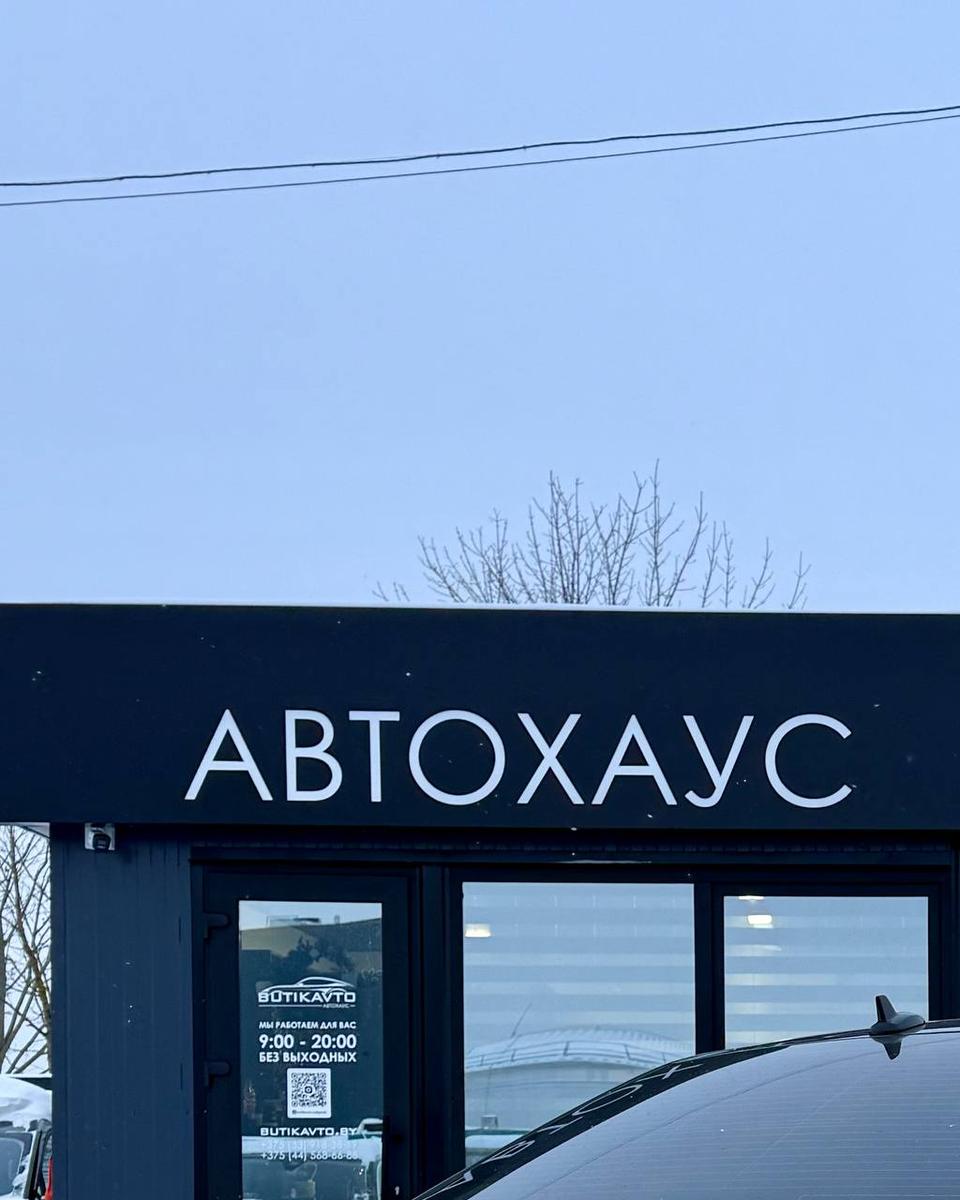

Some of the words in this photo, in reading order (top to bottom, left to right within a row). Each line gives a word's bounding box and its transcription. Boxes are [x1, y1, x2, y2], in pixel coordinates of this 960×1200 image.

[184, 708, 853, 809] АВТОХАУС
[258, 991, 356, 1003] BUTIKAVTO
[259, 1021, 274, 1029] МЫ
[275, 1021, 318, 1029] РАБОТАЕМ
[320, 1021, 337, 1029] ДЛЯ
[339, 1021, 357, 1029] ВАС
[259, 1034, 295, 1049] 9:00
[311, 1034, 357, 1049] 20:00
[259, 1052, 280, 1062] БЕЗ
[283, 1052, 357, 1064] ВЫХОДНЫХ
[260, 1127, 358, 1136] BUTIKAVTO.BY
[261, 1151, 285, 1160] +375
[288, 1151, 307, 1162] (44)
